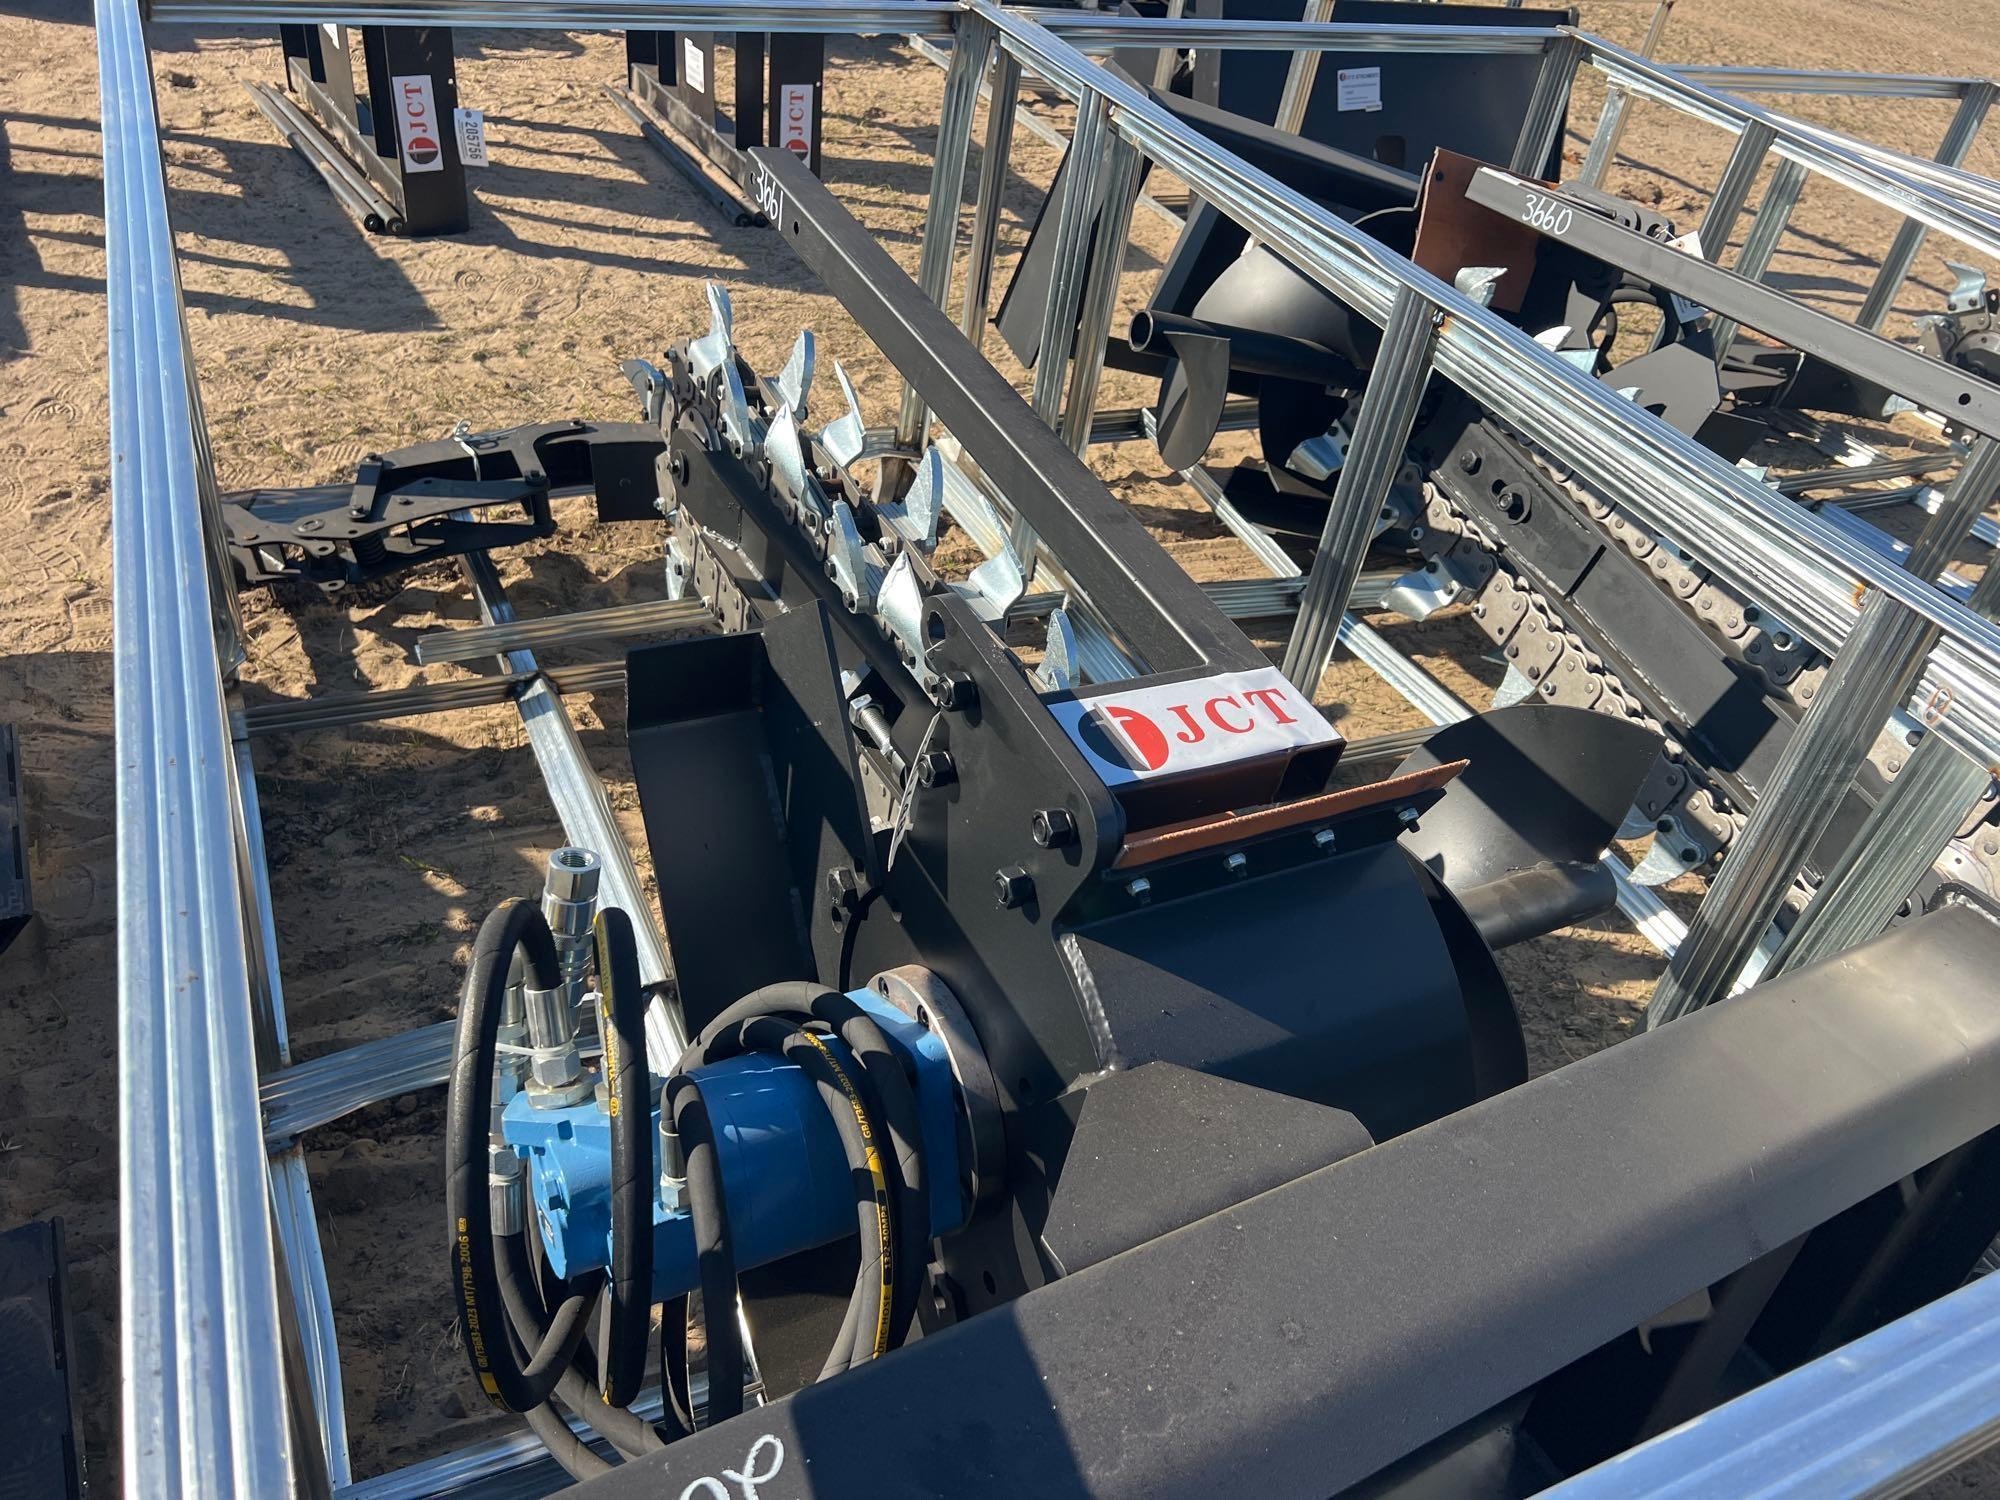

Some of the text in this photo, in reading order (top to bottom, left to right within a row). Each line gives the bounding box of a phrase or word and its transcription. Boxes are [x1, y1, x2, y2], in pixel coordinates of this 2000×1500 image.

[403, 82, 428, 133] JCT
[789, 90, 804, 136] JCT
[464, 121, 483, 160] 205756
[756, 162, 784, 231] 3661
[1521, 193, 1573, 235] 3660
[1166, 688, 1298, 744] JCT
